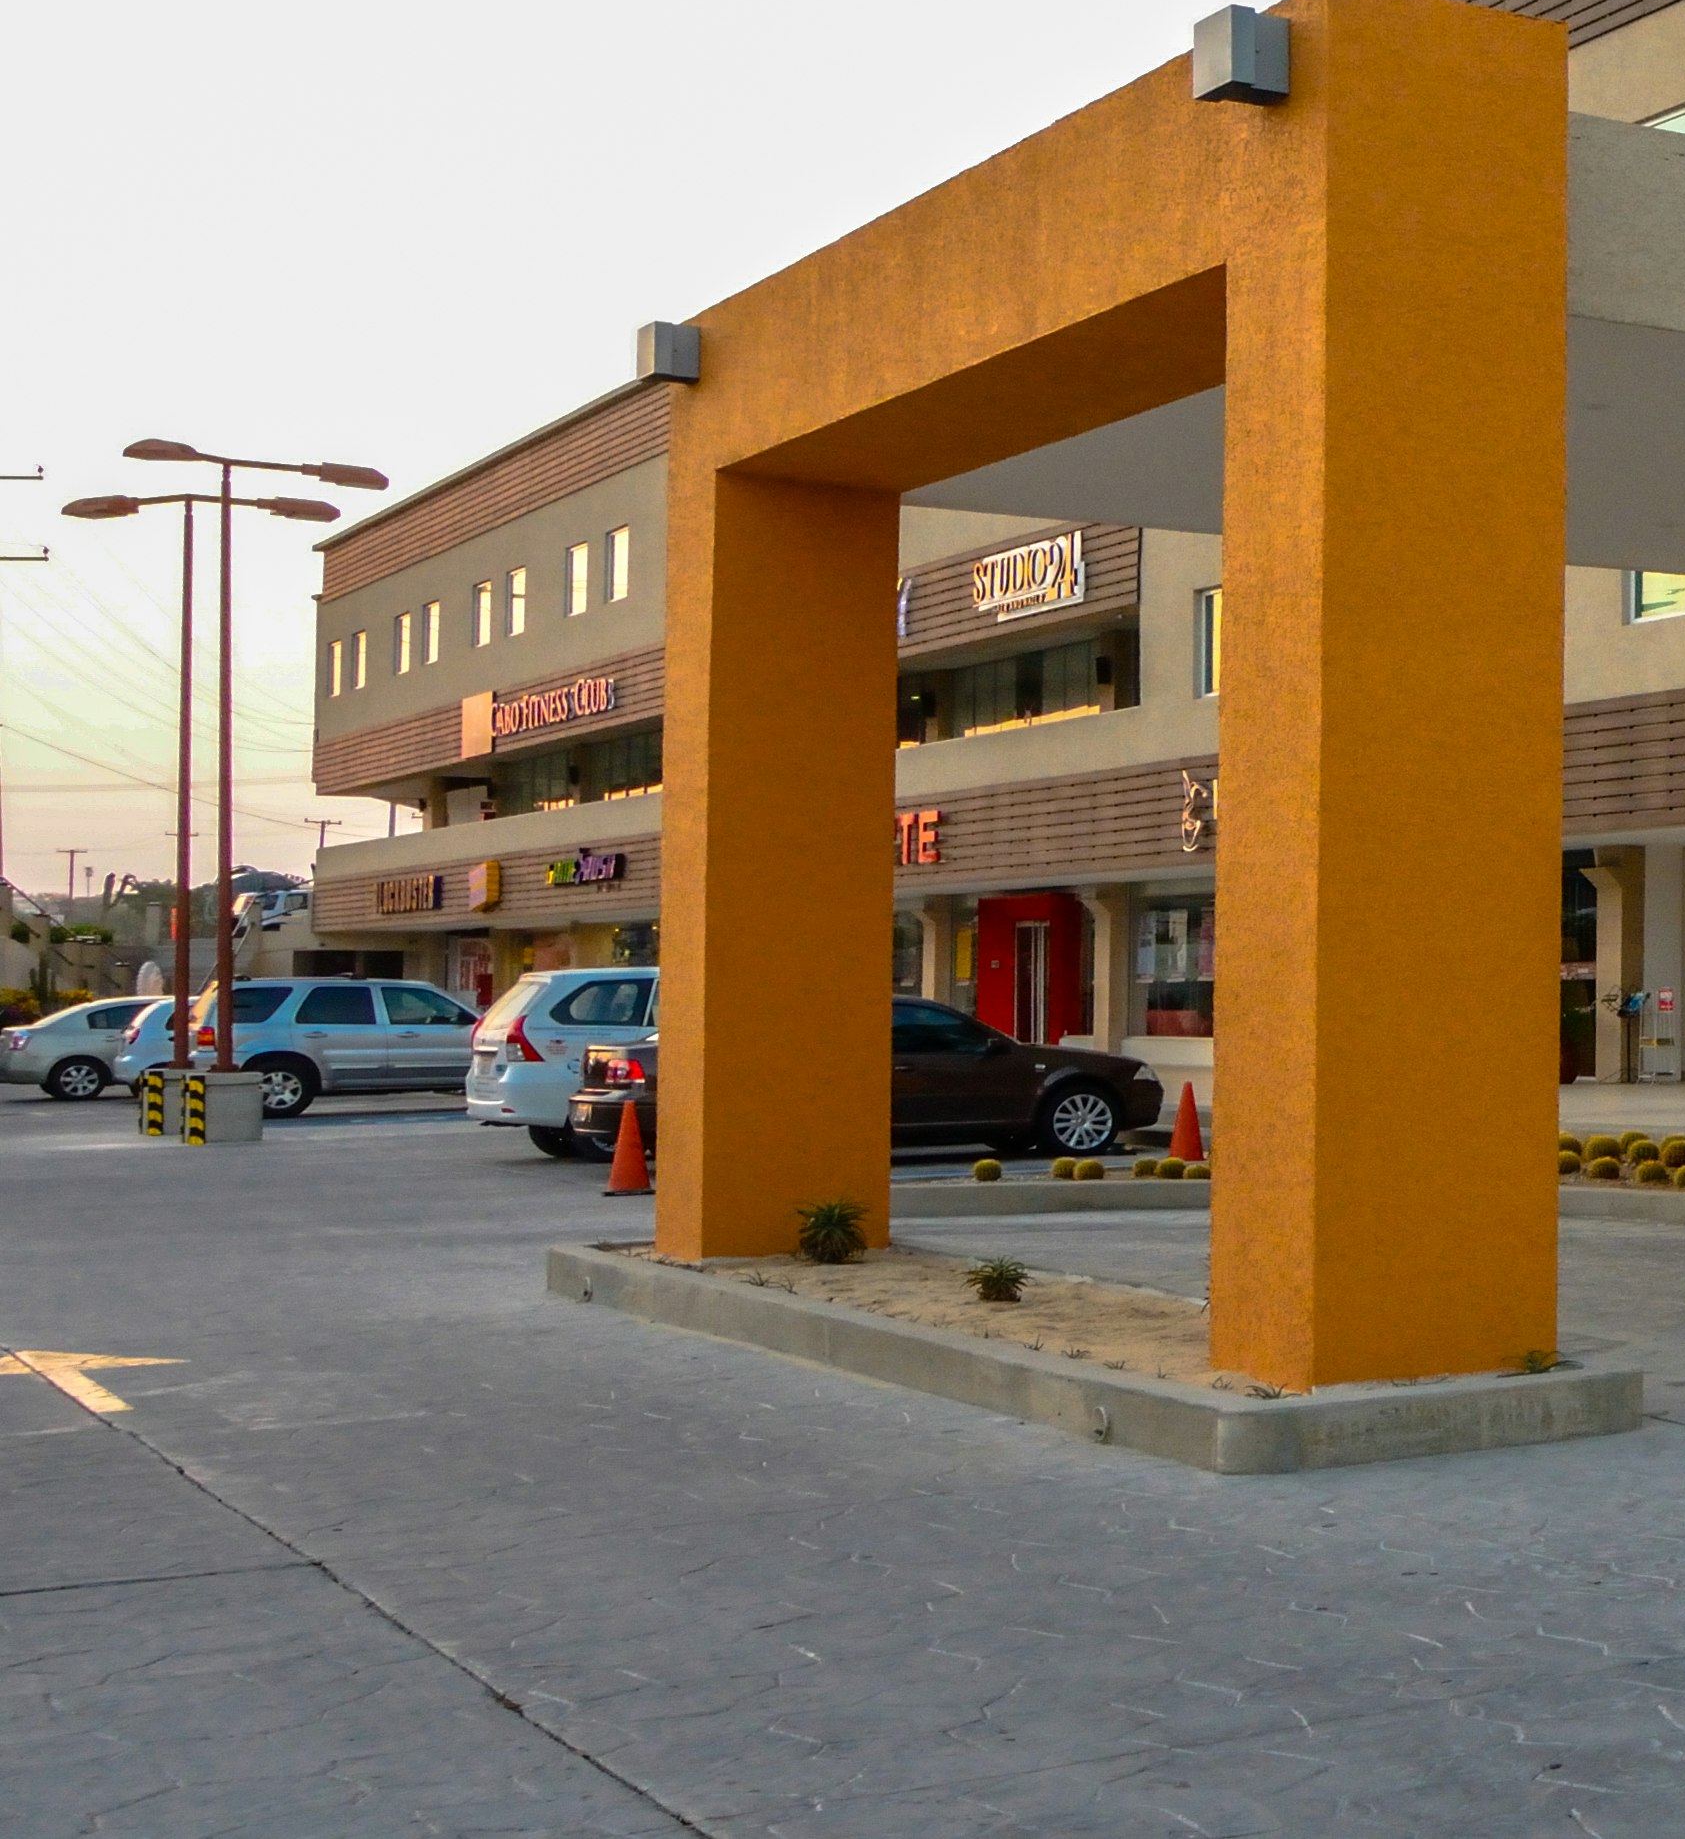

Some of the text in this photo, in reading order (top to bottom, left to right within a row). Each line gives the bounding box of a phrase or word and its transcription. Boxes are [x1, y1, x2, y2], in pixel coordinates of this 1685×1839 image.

[491, 677, 616, 738] CABO FITNESS CLUB
[895, 810, 942, 865] TE
